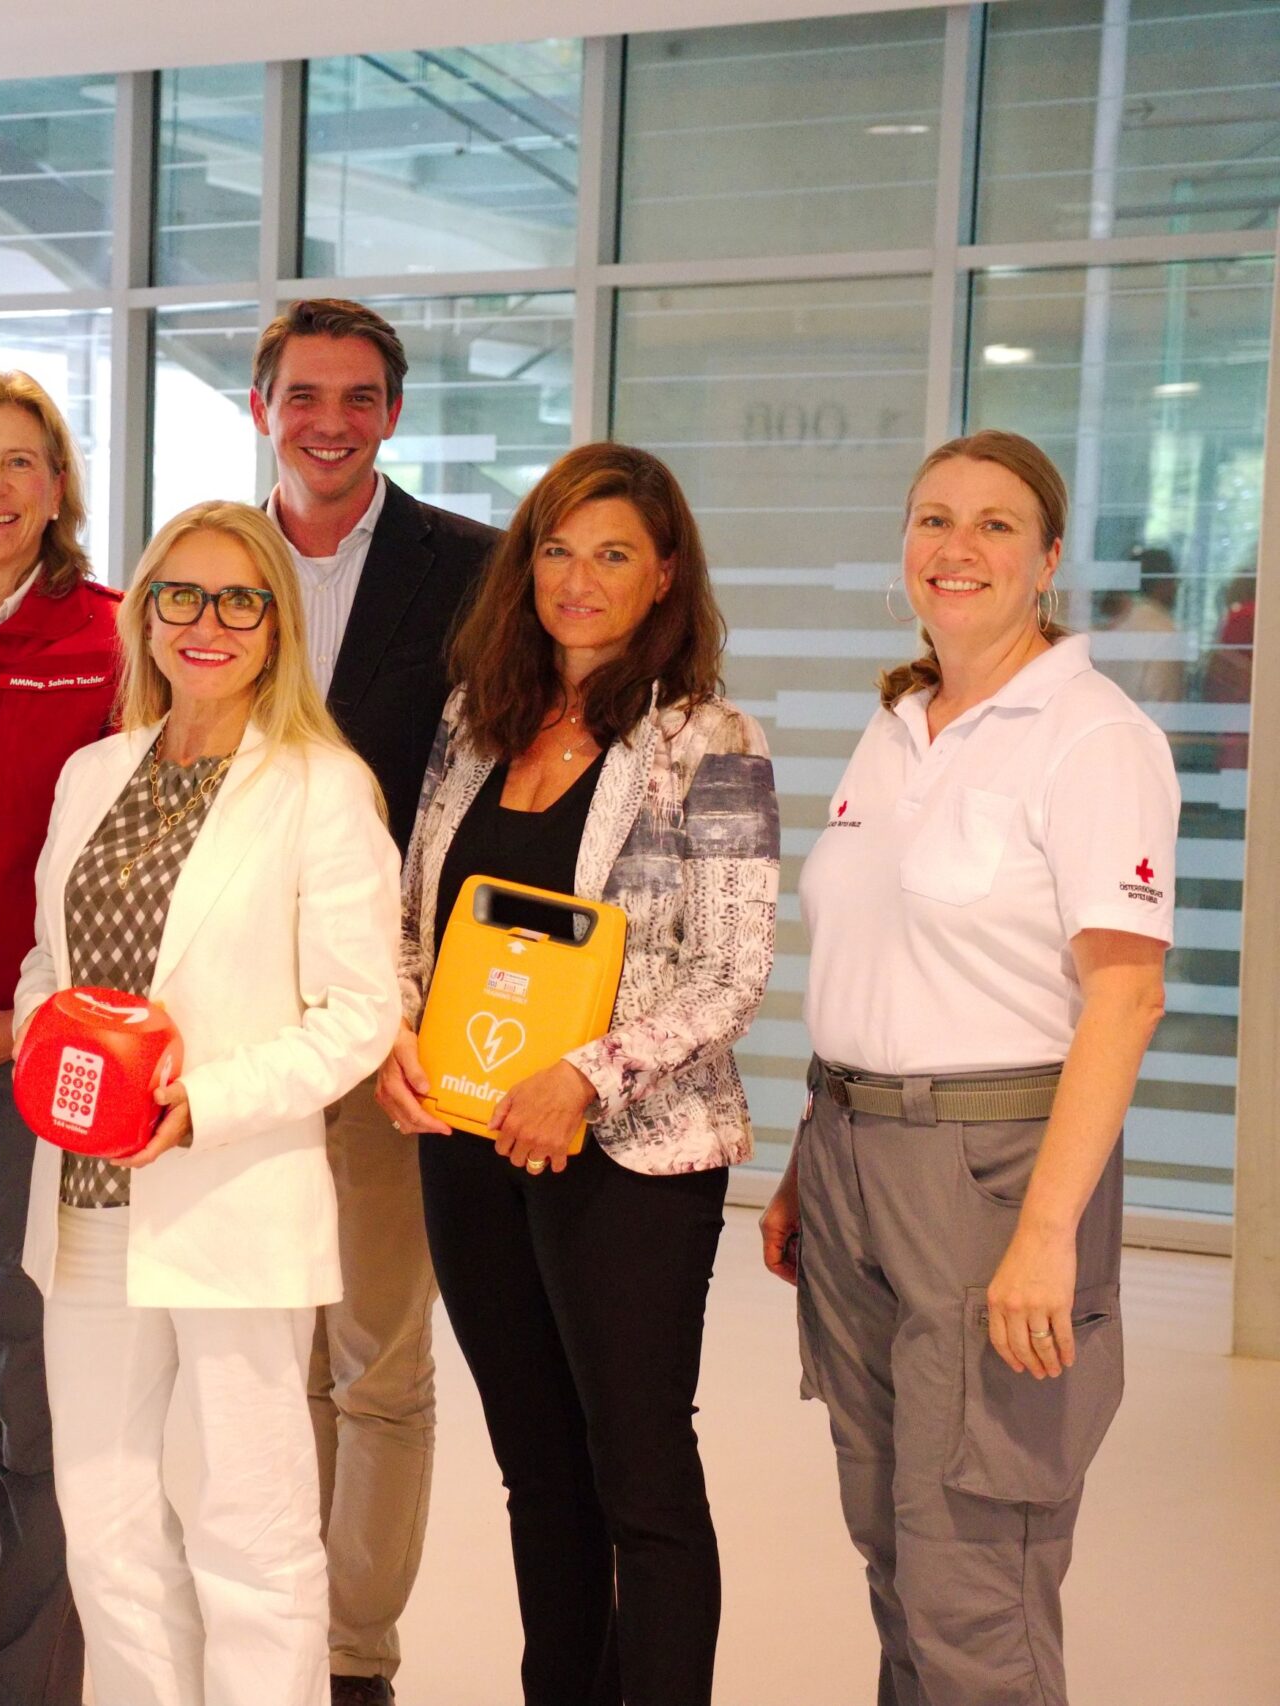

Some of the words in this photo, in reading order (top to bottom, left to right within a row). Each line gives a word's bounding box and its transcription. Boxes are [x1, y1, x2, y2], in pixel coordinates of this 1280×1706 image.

[10, 677, 46, 690] MMMag.
[48, 677, 75, 688] Sabine
[76, 675, 105, 685] Tischler
[441, 1074, 508, 1104] mindra
